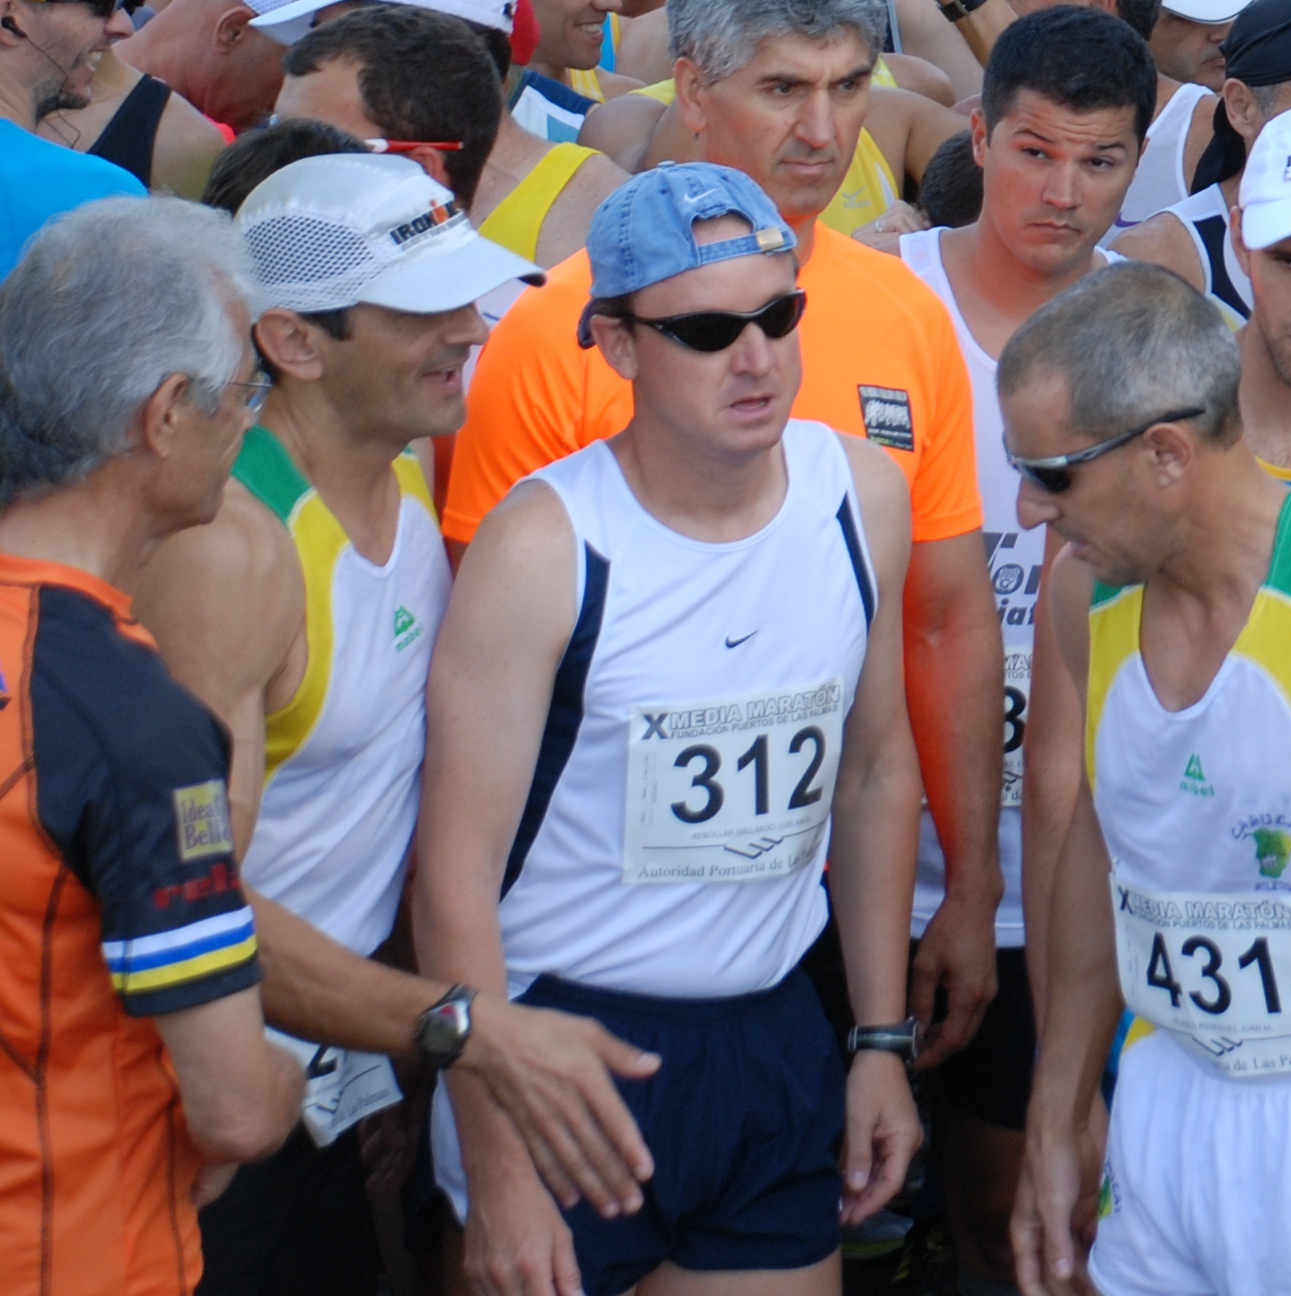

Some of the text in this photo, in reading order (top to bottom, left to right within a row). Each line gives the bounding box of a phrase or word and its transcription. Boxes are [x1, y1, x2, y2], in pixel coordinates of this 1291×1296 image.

[642, 684, 840, 740] X MEDIA MARATÓN
[671, 704, 839, 739] FUNDACIÓN PUERTOS DE LAS PALMAS
[670, 725, 827, 824] 312
[638, 863, 705, 878] Autoridad
[709, 859, 766, 877] Portuaria
[769, 855, 784, 869] de
[1118, 886, 1134, 915] X
[1217, 919, 1230, 930] DE
[1232, 919, 1251, 930] LAS
[1147, 931, 1283, 1016] 431
[1233, 1057, 1250, 1072] de
[1253, 1056, 1277, 1070] Las
